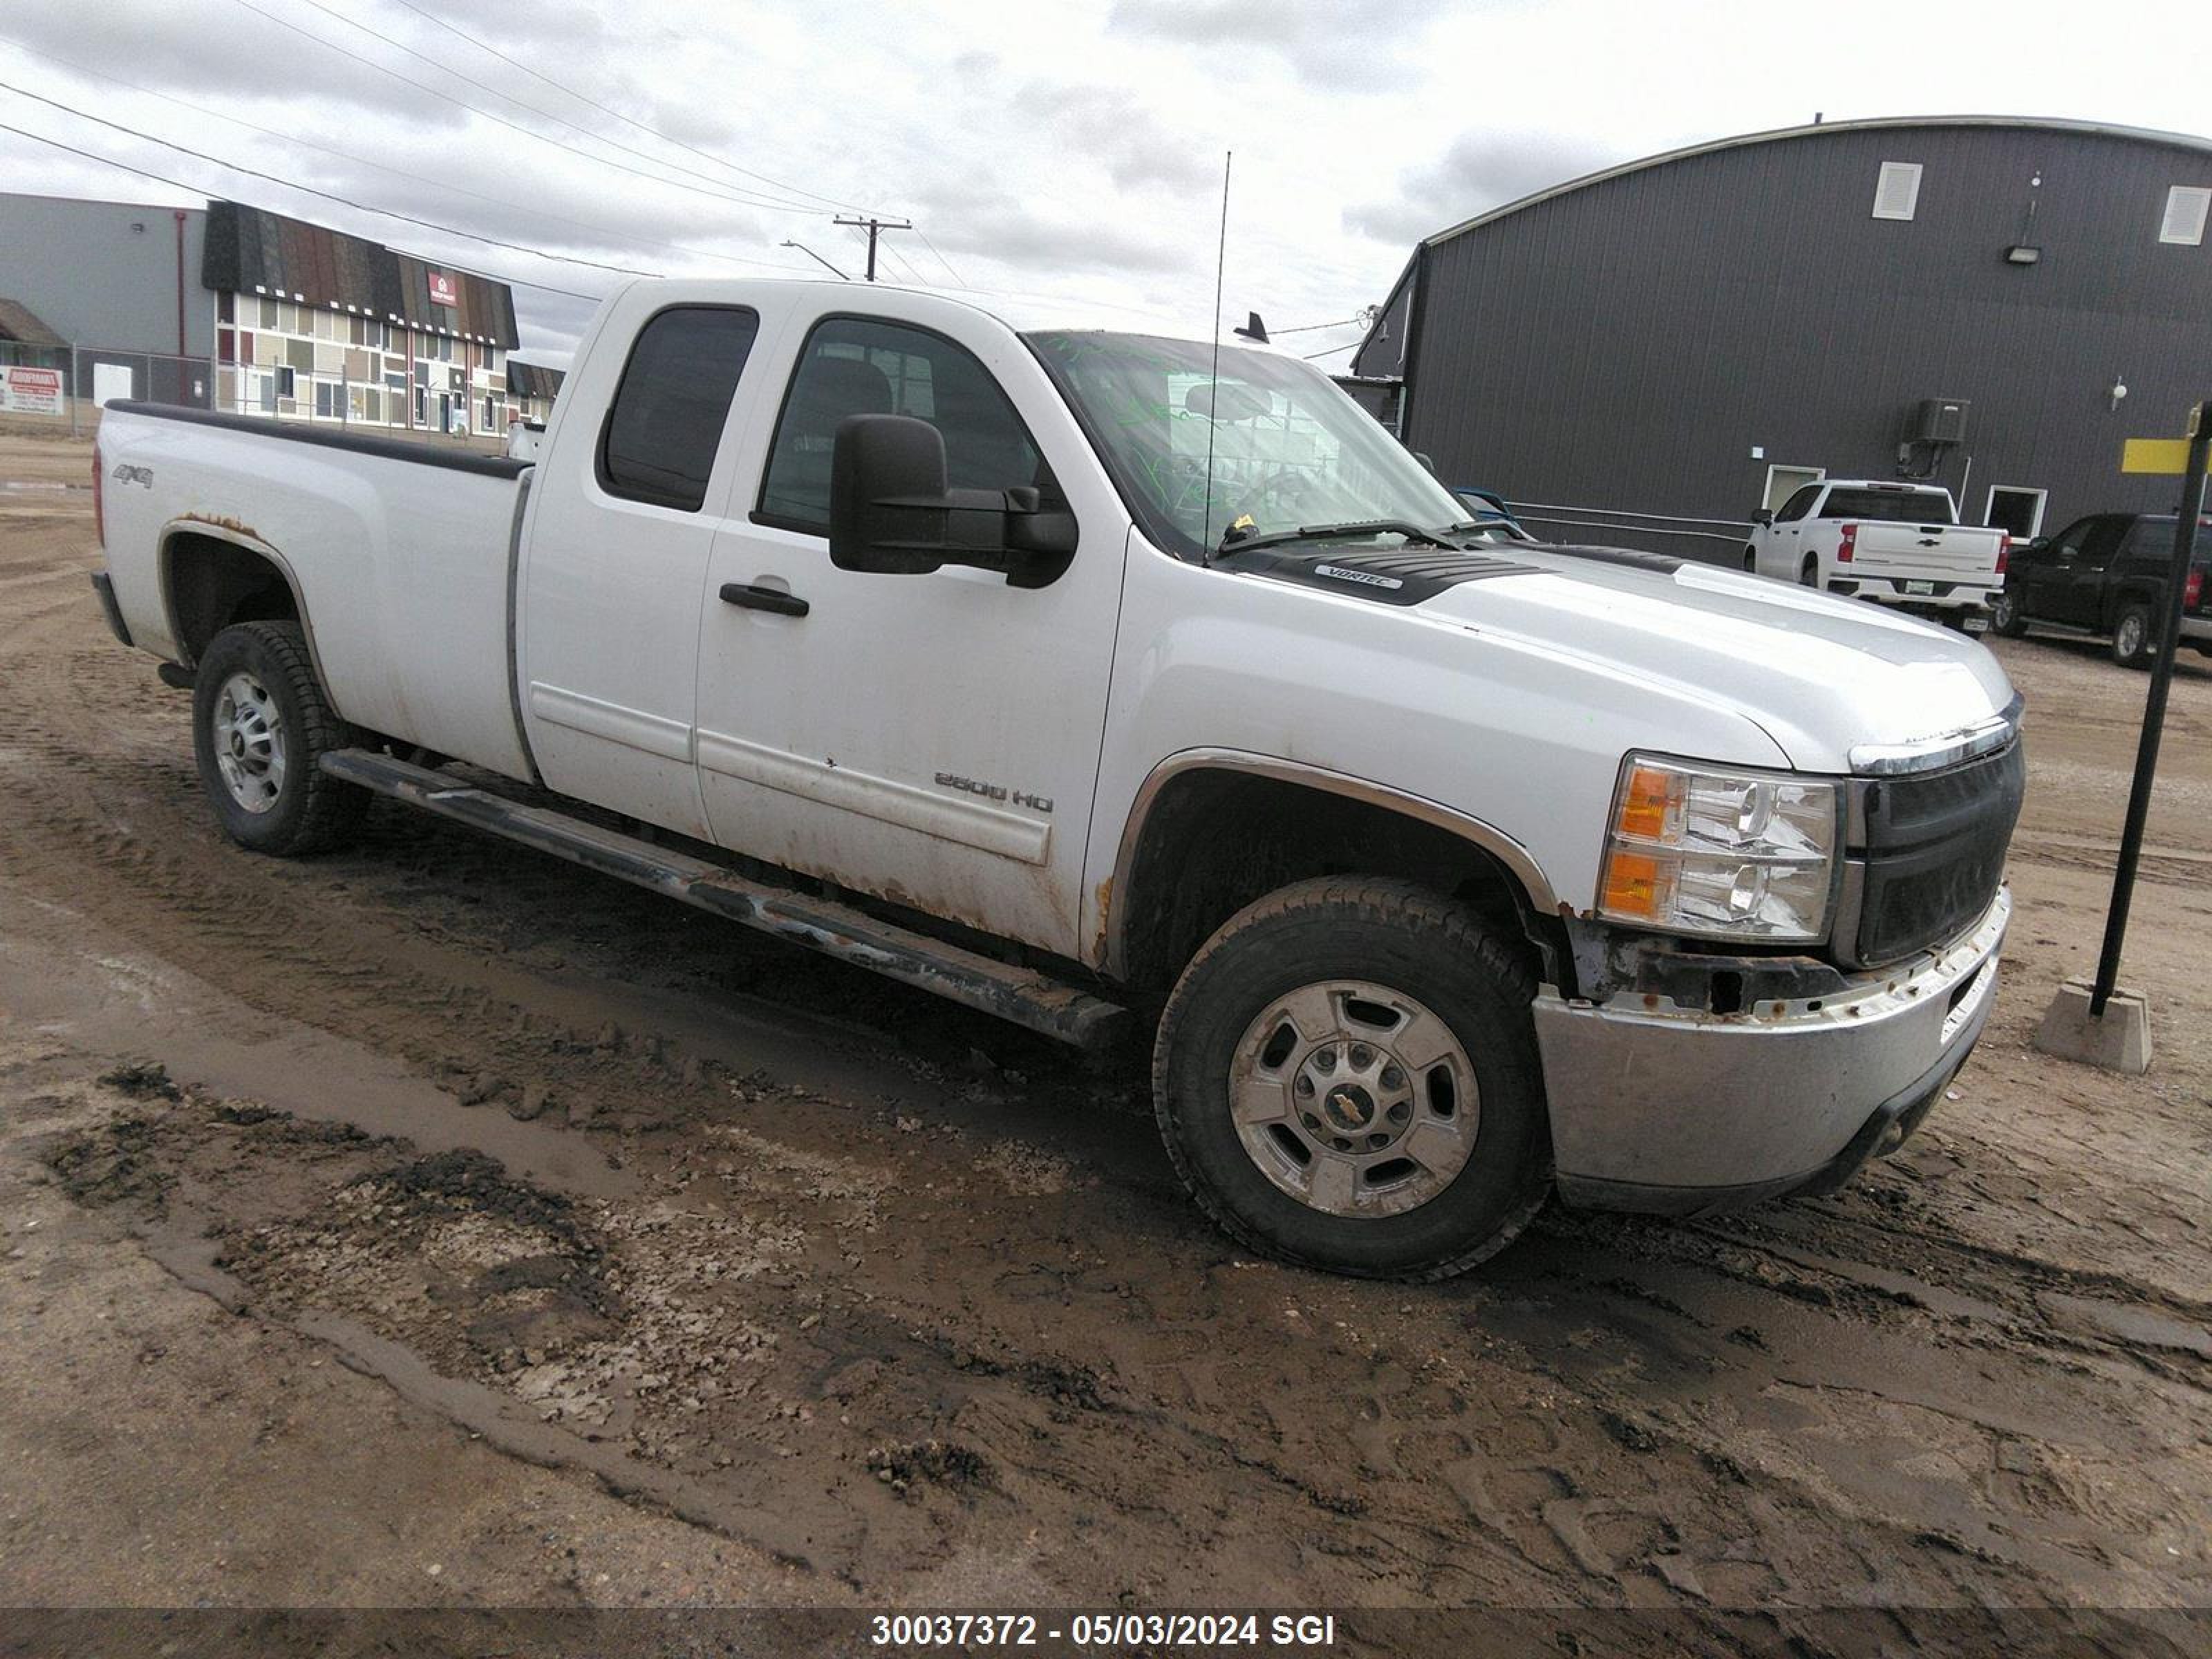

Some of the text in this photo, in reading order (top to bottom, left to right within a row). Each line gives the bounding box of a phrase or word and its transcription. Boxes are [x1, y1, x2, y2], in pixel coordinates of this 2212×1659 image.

[1328, 567, 1391, 585] VORTEC
[935, 772, 1053, 813] 2500 HD
